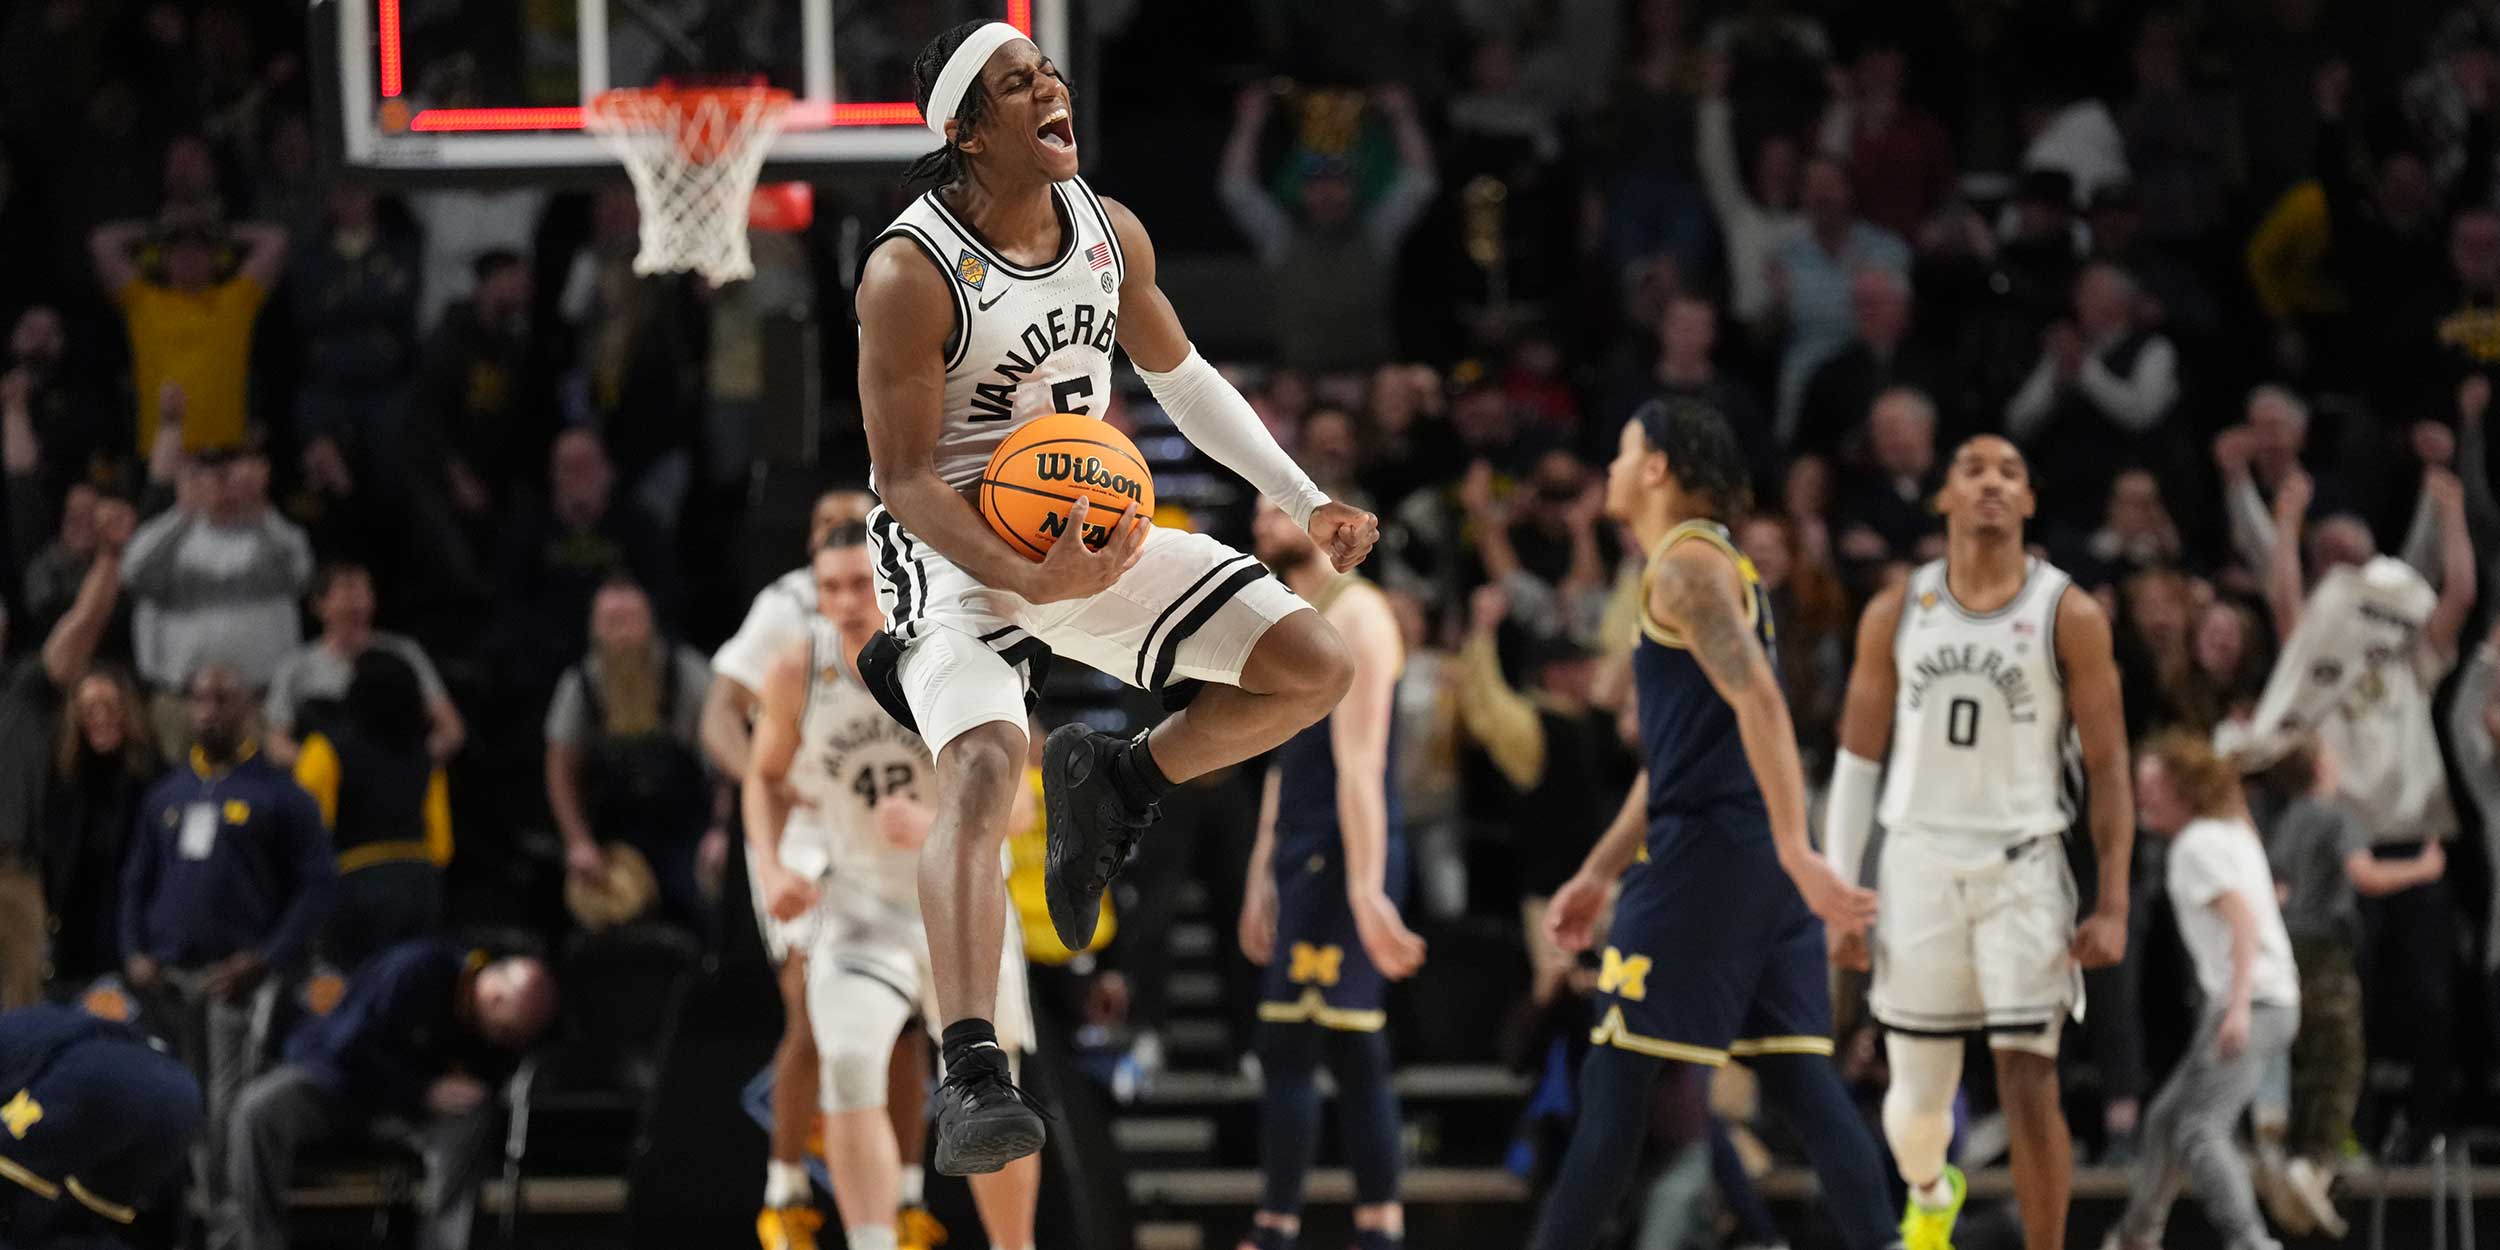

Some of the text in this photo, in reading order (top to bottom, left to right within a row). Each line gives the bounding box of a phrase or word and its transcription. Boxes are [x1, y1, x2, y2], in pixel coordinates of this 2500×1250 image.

[968, 304, 1116, 422] VANDERB
[1036, 452, 1142, 502] Wilson
[1948, 698, 1979, 745] 0
[1597, 946, 1653, 1001] M
